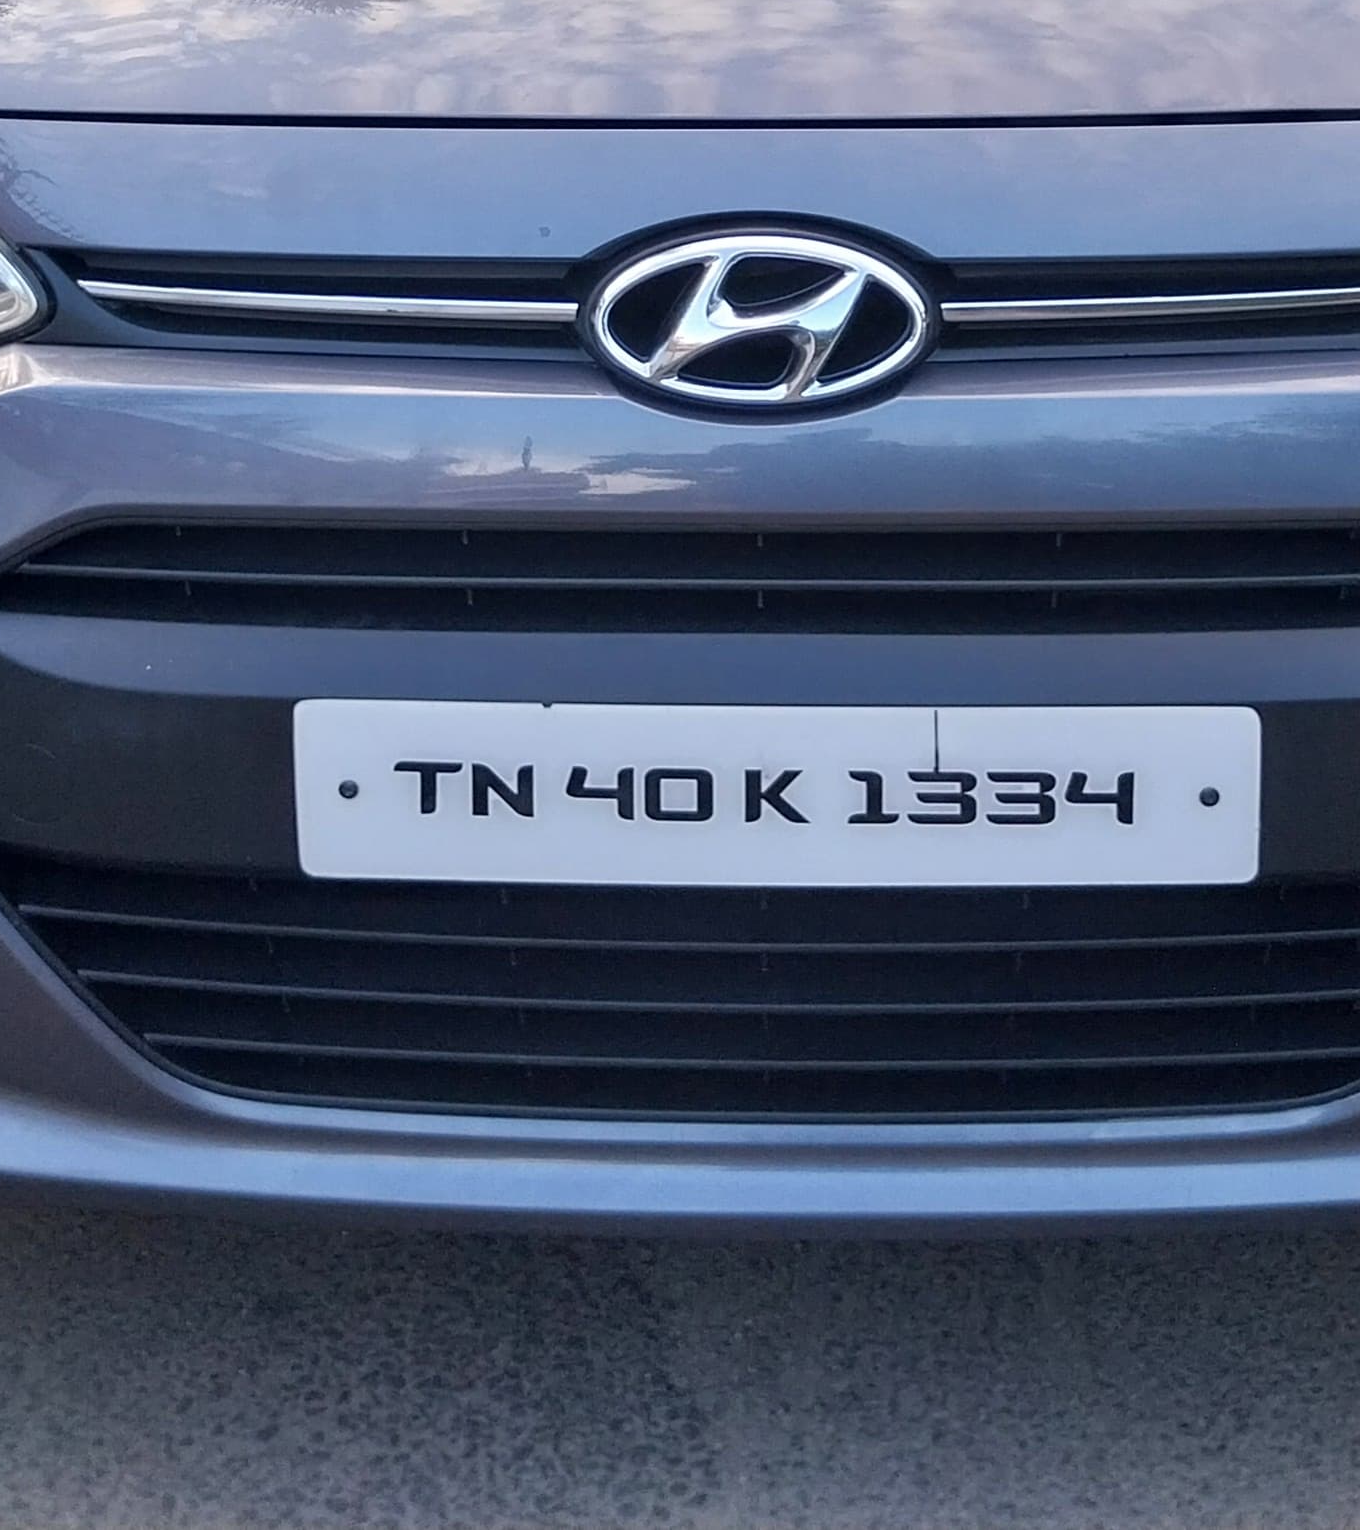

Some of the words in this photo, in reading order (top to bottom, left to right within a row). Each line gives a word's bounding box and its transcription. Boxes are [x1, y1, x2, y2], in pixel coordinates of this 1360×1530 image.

[392, 760, 536, 819] TN
[564, 765, 715, 823] 40
[743, 768, 811, 825] K
[846, 769, 1136, 826] 1334
